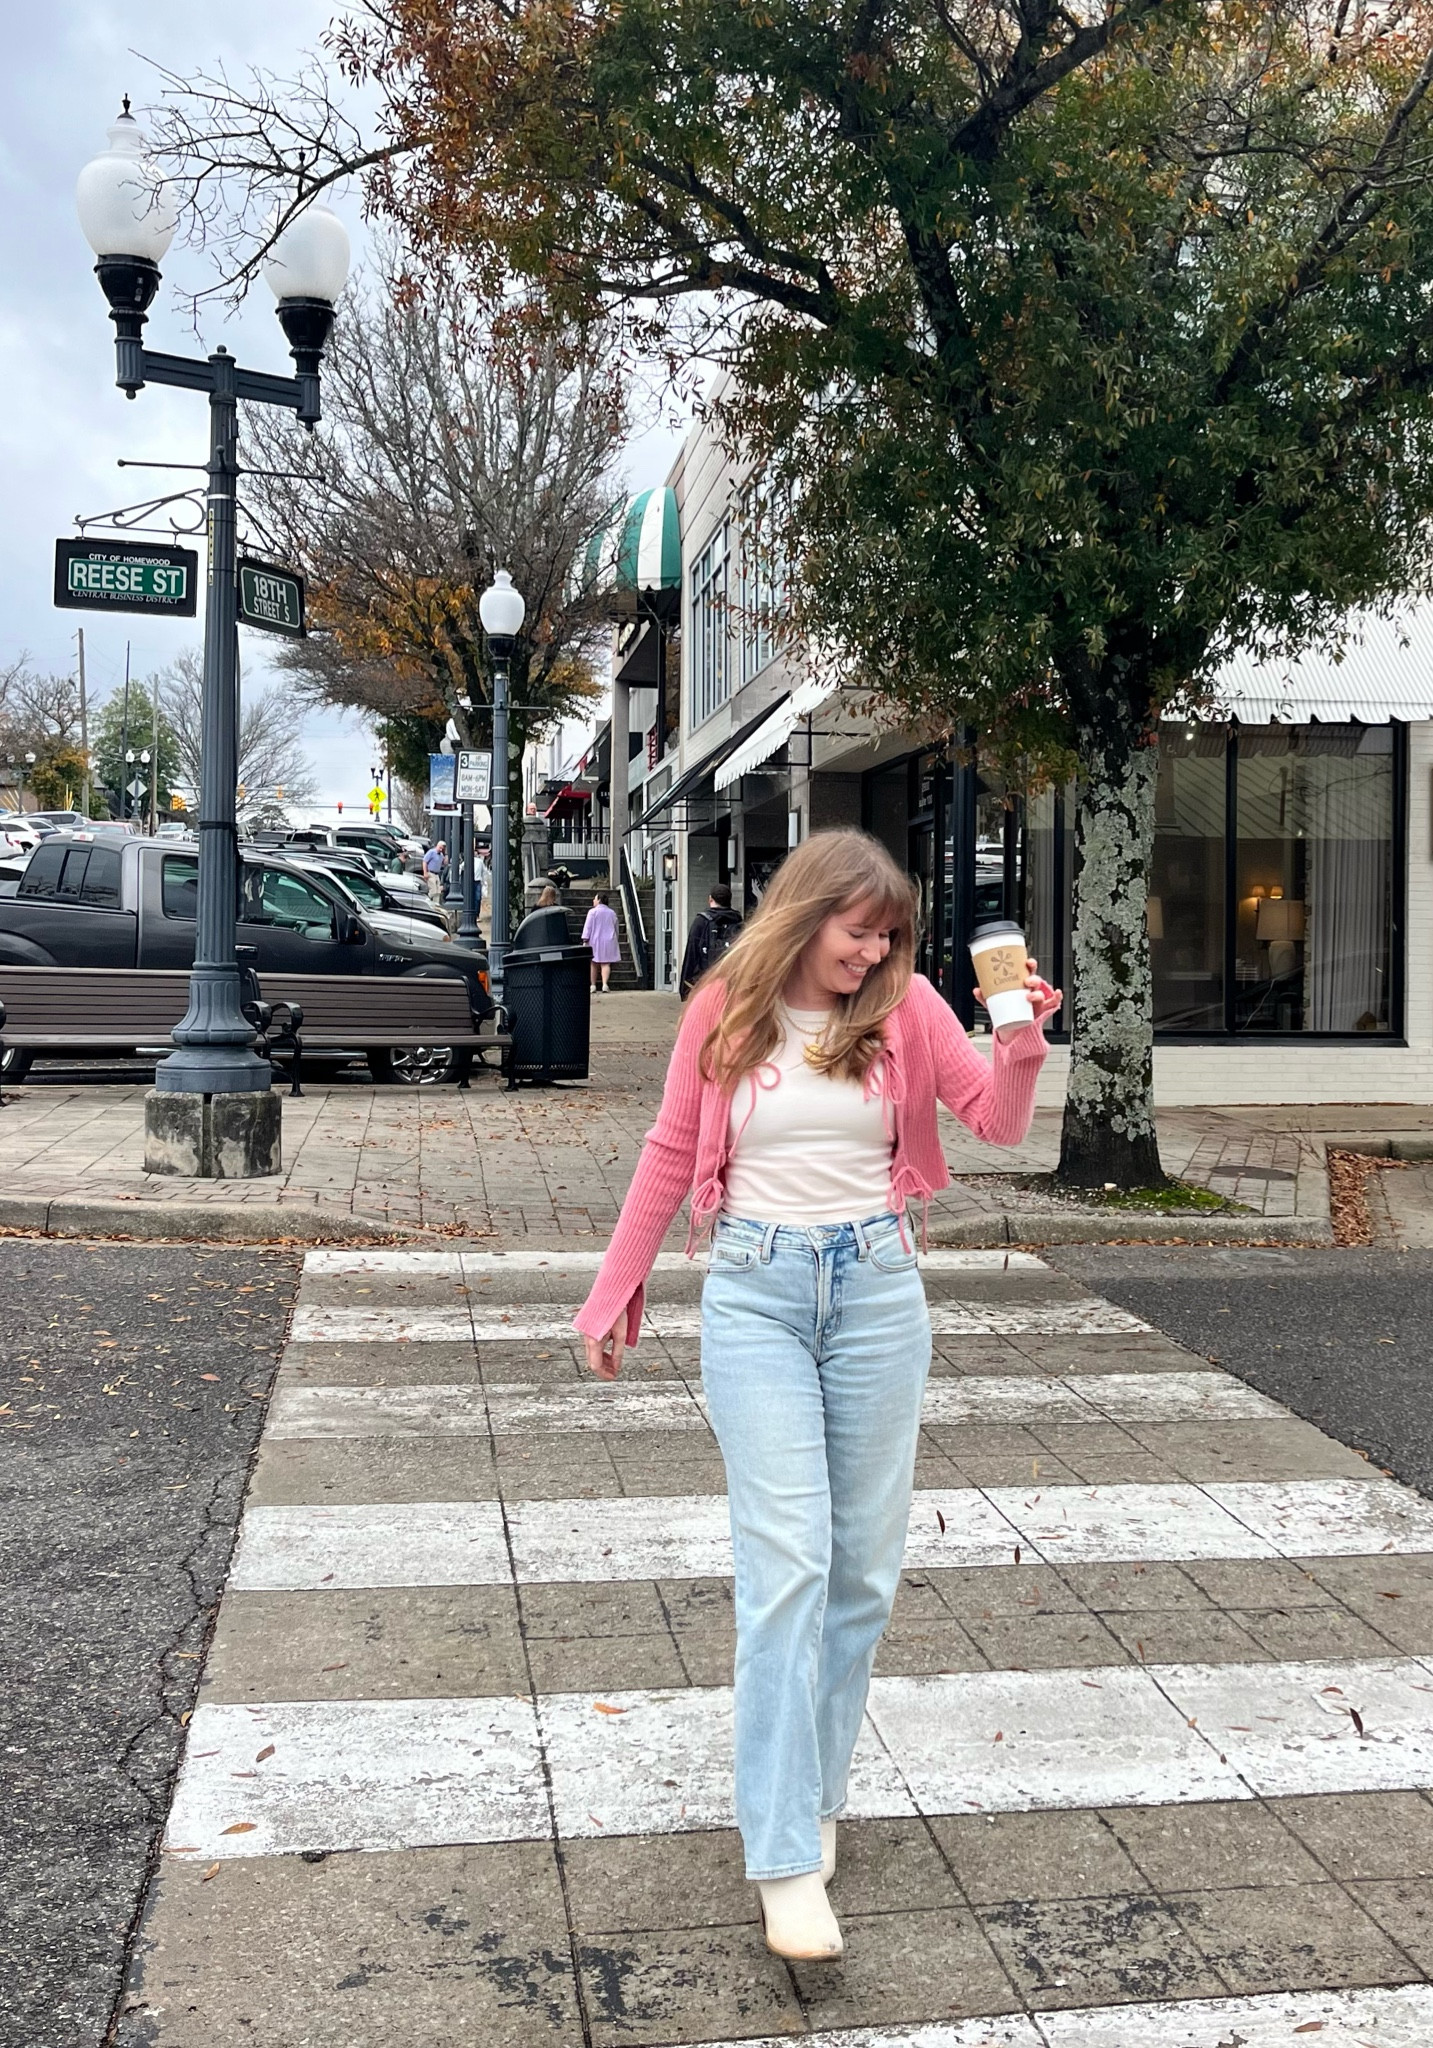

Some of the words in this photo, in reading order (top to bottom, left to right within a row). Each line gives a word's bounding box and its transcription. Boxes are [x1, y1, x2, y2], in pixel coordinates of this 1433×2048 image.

[88, 553, 107, 561] CITY
[123, 556, 171, 566] HOMEWOOD
[73, 562, 144, 592] REESE
[152, 568, 180, 594] ST
[72, 590, 108, 600] CENTRAL
[109, 591, 144, 602] BUSINESS
[145, 595, 179, 604] DISTRICT
[253, 575, 287, 605] 18TH
[253, 596, 280, 620] STREET
[284, 605, 290, 622] S
[461, 755, 468, 768] 3
